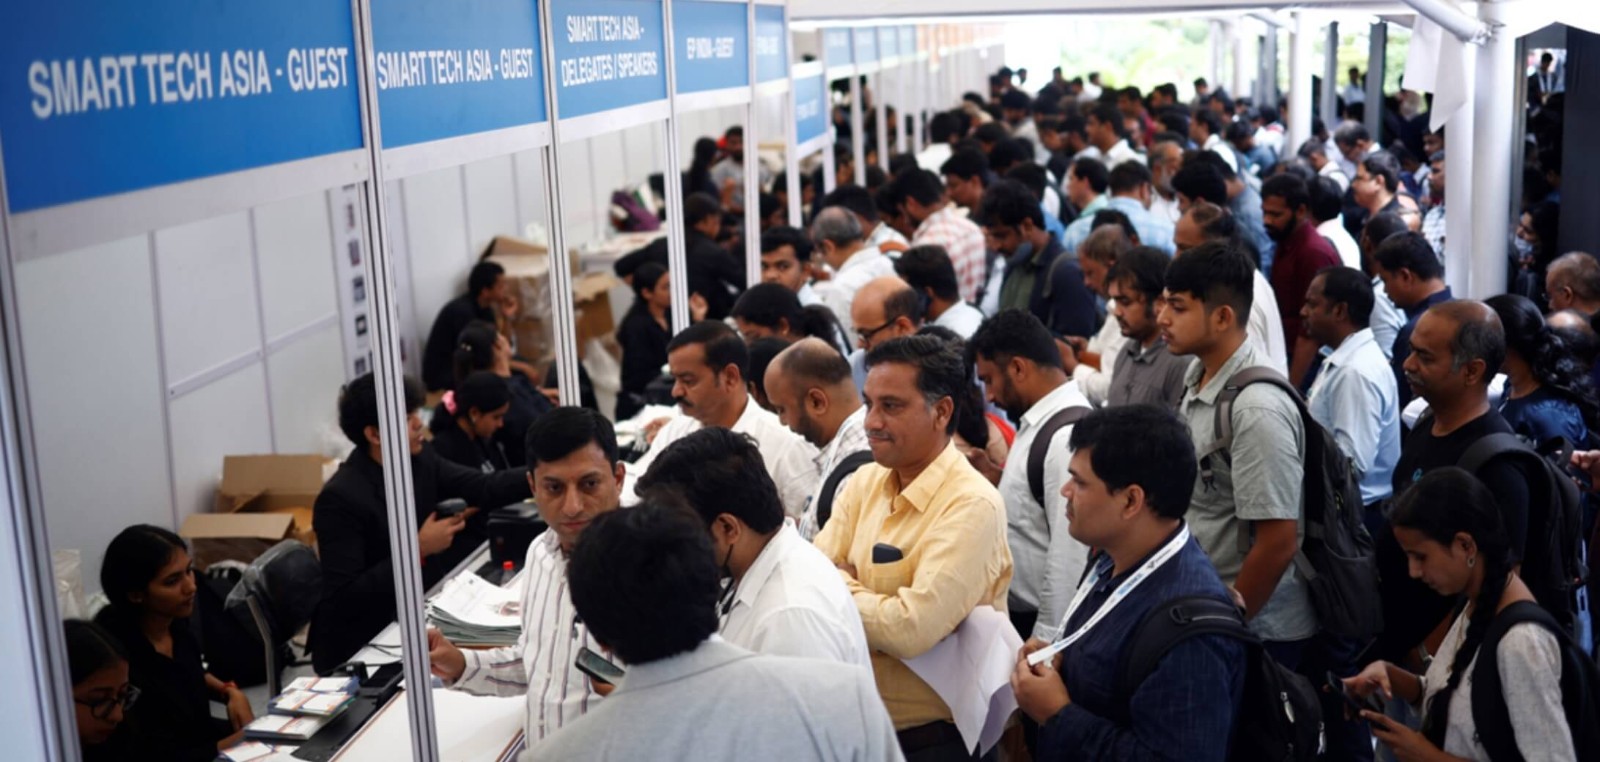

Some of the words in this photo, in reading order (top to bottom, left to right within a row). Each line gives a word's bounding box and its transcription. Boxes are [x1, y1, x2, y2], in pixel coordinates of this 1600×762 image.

[566, 15, 598, 43] SMART
[598, 15, 620, 41] TECH
[622, 15, 641, 41] ASIA
[28, 57, 137, 119] SMART
[141, 52, 213, 104] TECH
[219, 50, 272, 98] ASIA
[287, 47, 348, 92] GUEST
[377, 51, 427, 90] SMART
[428, 50, 464, 84] TECH
[466, 49, 494, 82] ASIA
[500, 48, 533, 79] GUEST
[561, 53, 613, 87] DELEGATES
